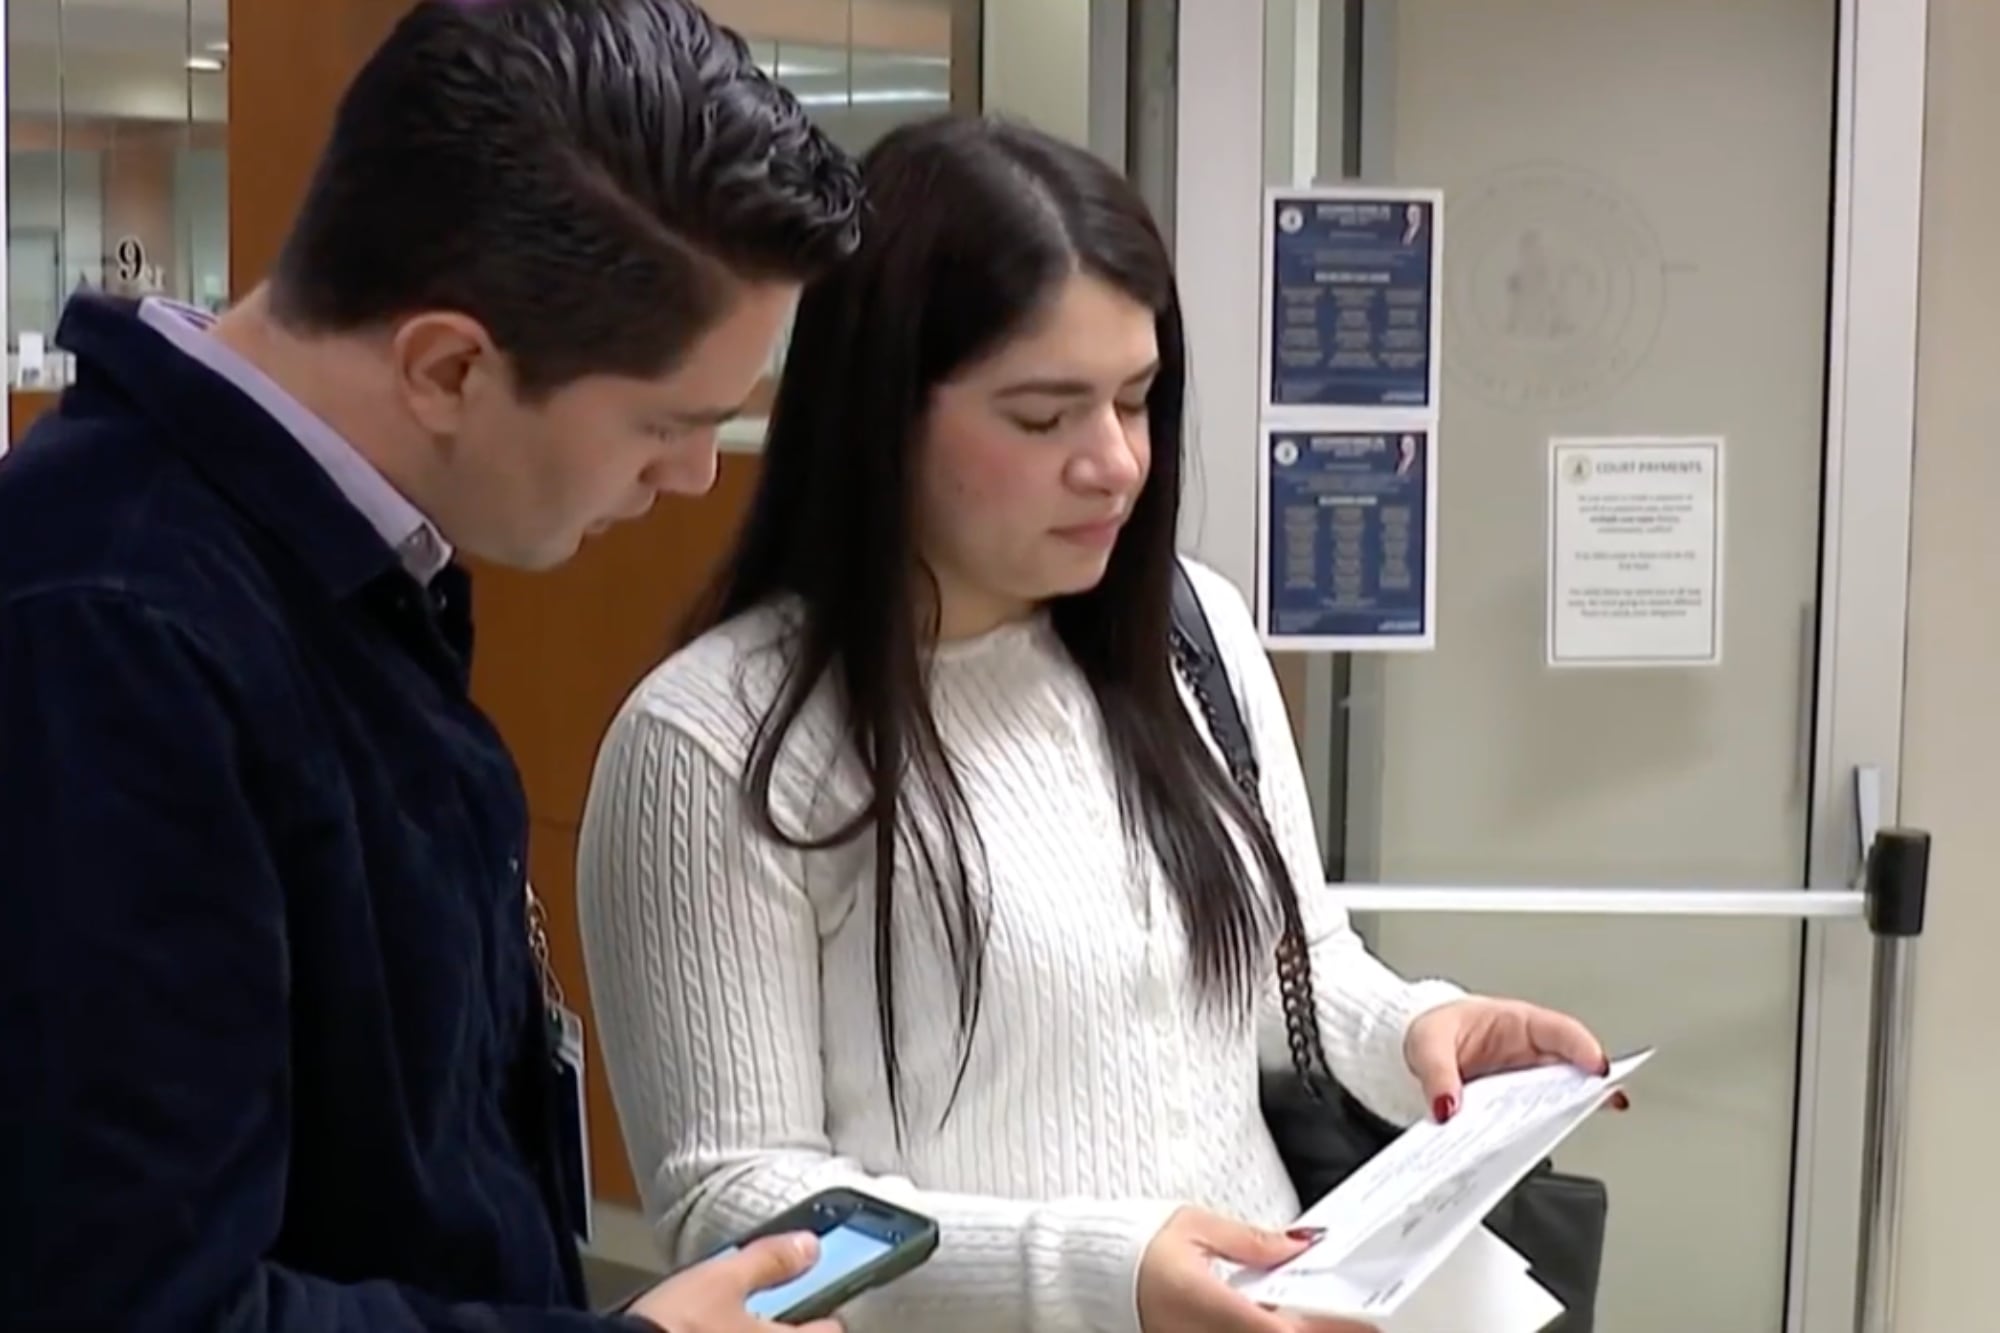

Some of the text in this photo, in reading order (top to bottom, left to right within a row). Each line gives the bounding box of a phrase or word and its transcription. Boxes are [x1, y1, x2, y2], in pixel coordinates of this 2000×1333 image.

[118, 239, 142, 280] 9
[1596, 460, 1703, 474] COURT PAYMENTS
